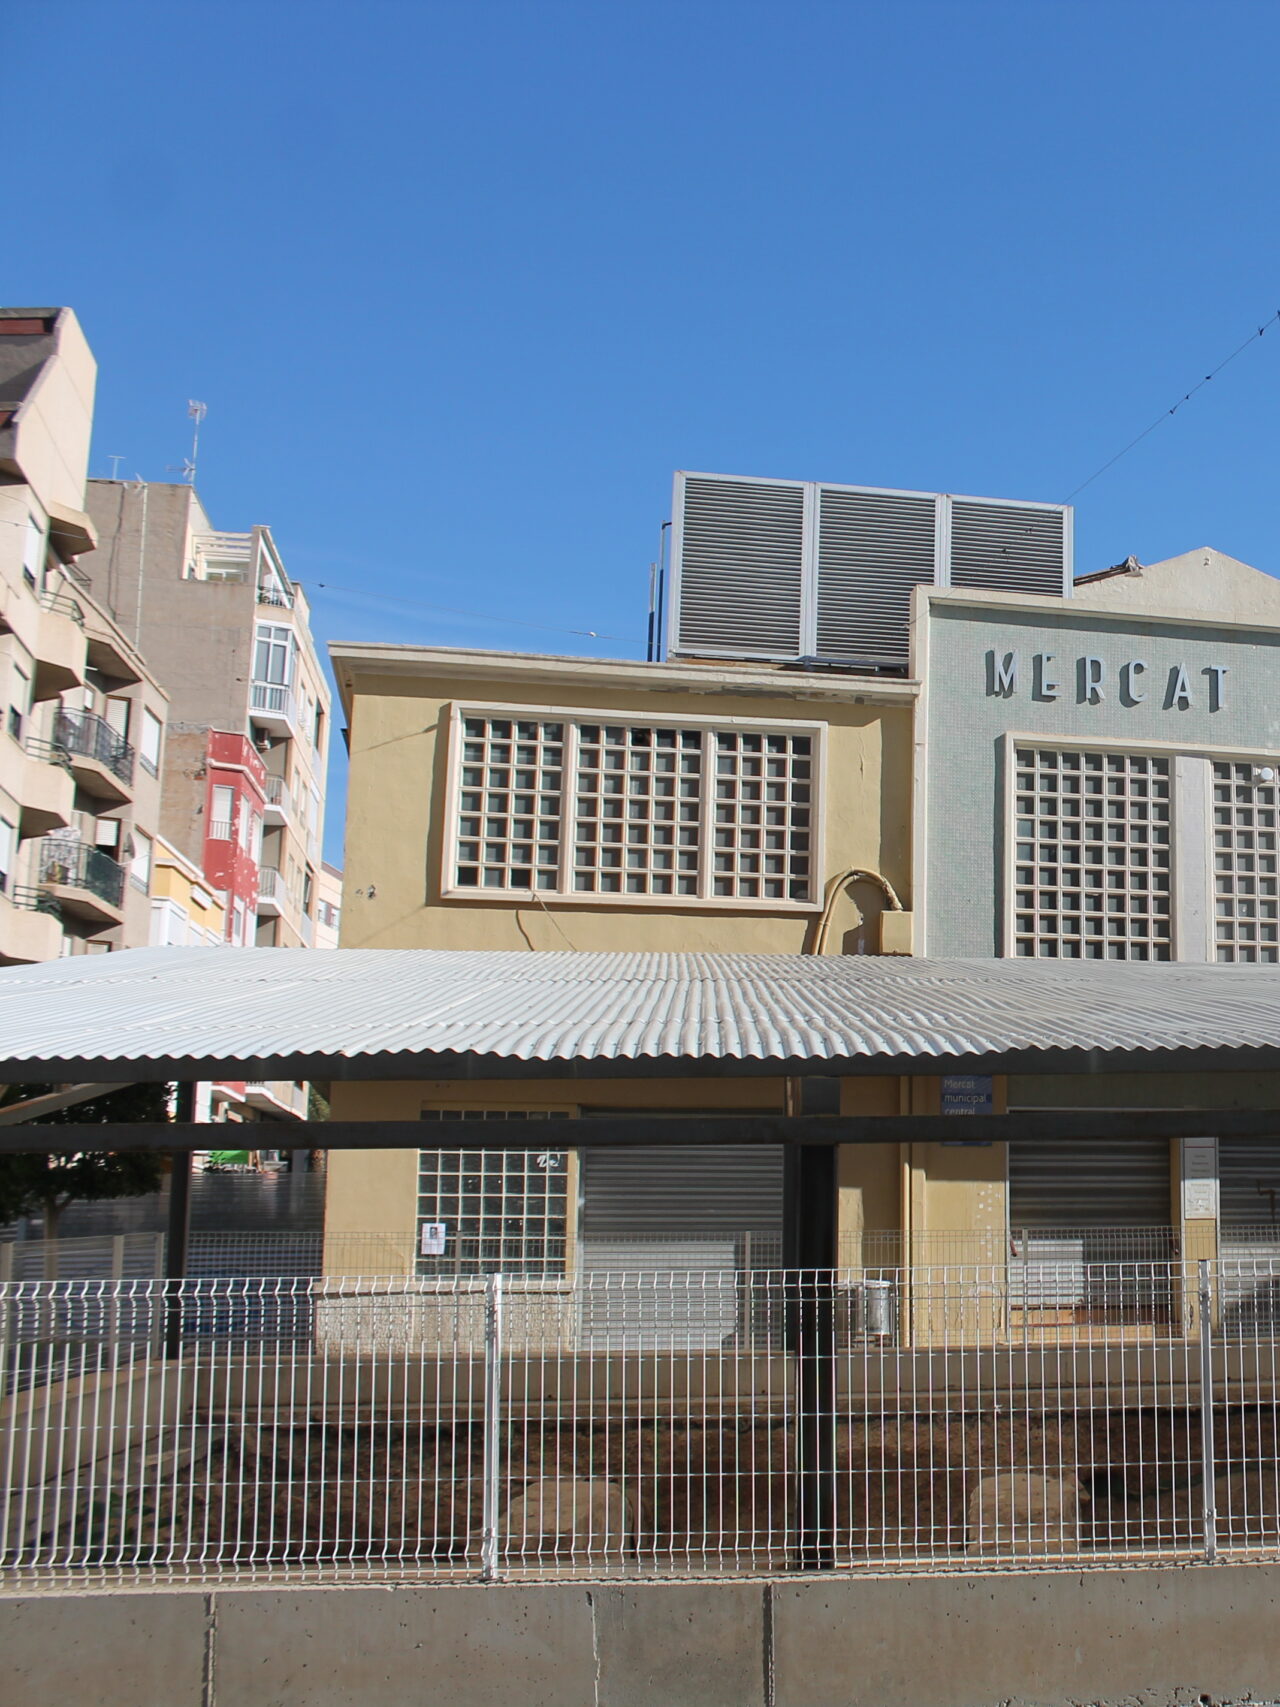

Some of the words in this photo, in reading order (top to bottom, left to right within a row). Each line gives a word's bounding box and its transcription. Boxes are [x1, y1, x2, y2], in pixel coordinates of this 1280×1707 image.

[992, 650, 1230, 711] MERCAT
[944, 1079, 976, 1089] Mercat
[944, 1093, 987, 1105] municipal
[944, 1106, 975, 1116] central
